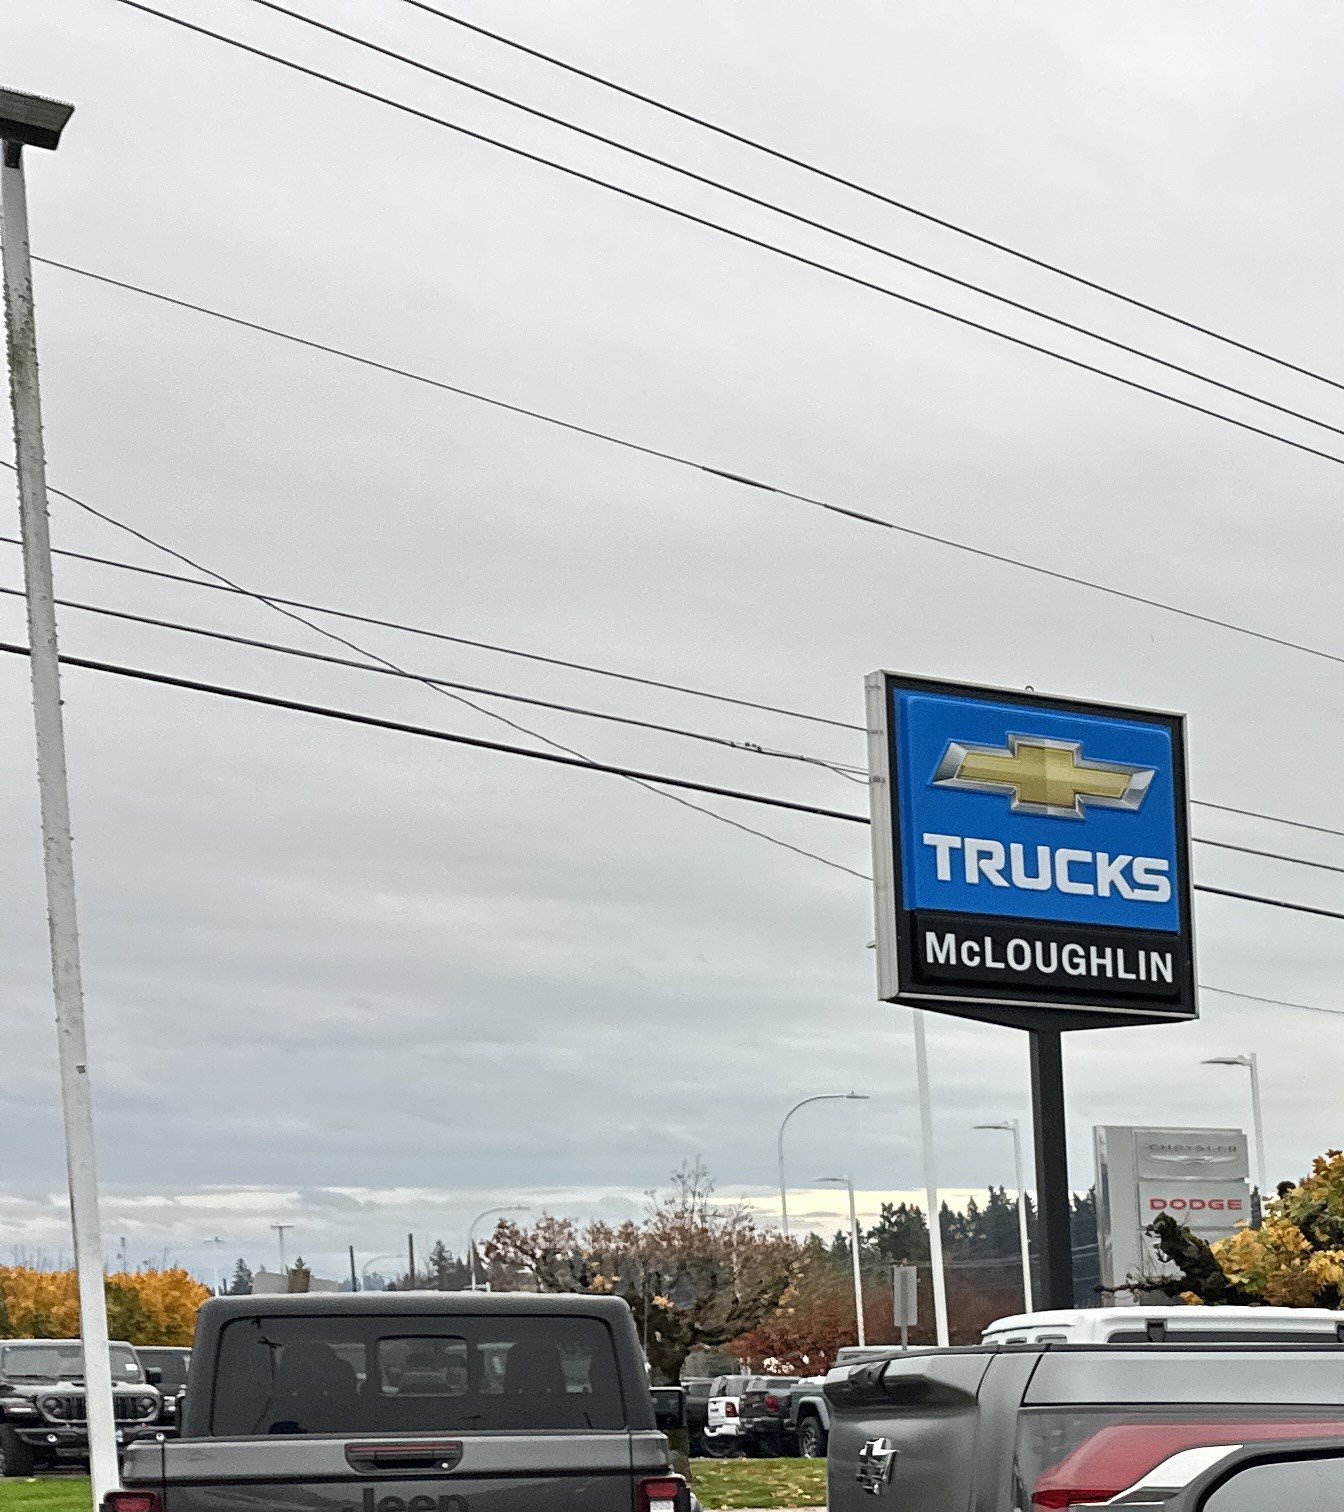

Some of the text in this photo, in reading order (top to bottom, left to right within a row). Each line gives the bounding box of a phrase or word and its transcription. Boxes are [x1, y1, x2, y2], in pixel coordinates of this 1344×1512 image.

[922, 832, 1172, 903] TRUCKS
[925, 931, 1174, 983] McLOUGHLIN
[1149, 1198, 1243, 1210] DODGE
